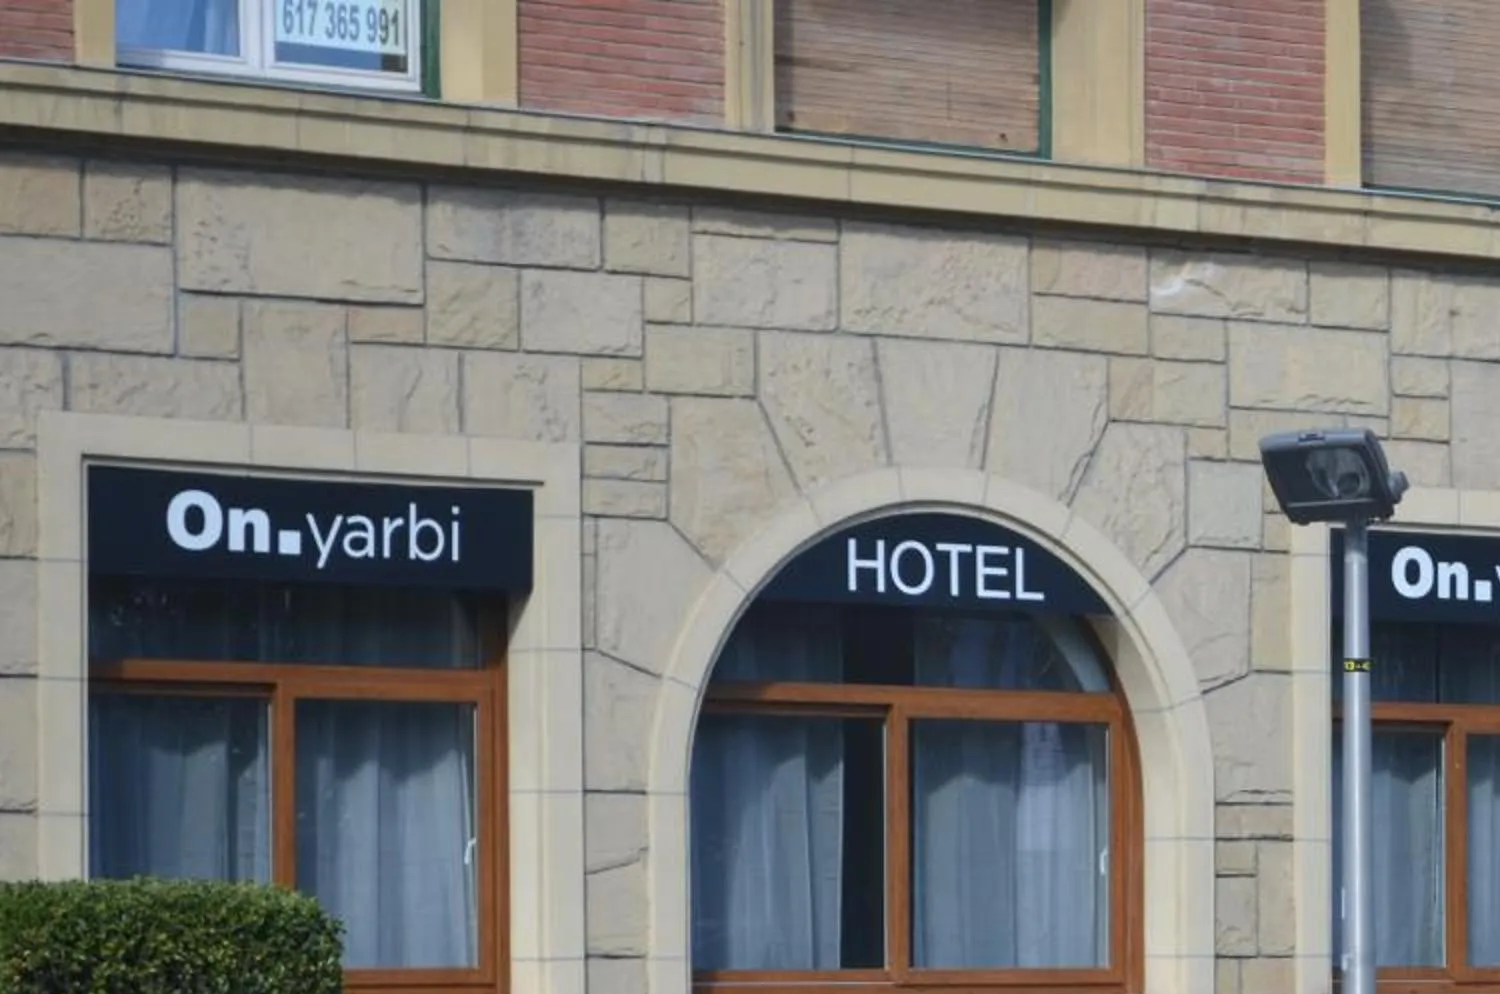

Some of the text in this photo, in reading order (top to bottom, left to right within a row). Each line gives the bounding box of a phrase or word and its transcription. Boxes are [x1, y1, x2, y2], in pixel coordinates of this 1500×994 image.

[282, 0, 399, 46] 617 365 991
[848, 538, 1045, 600] HOTEL
